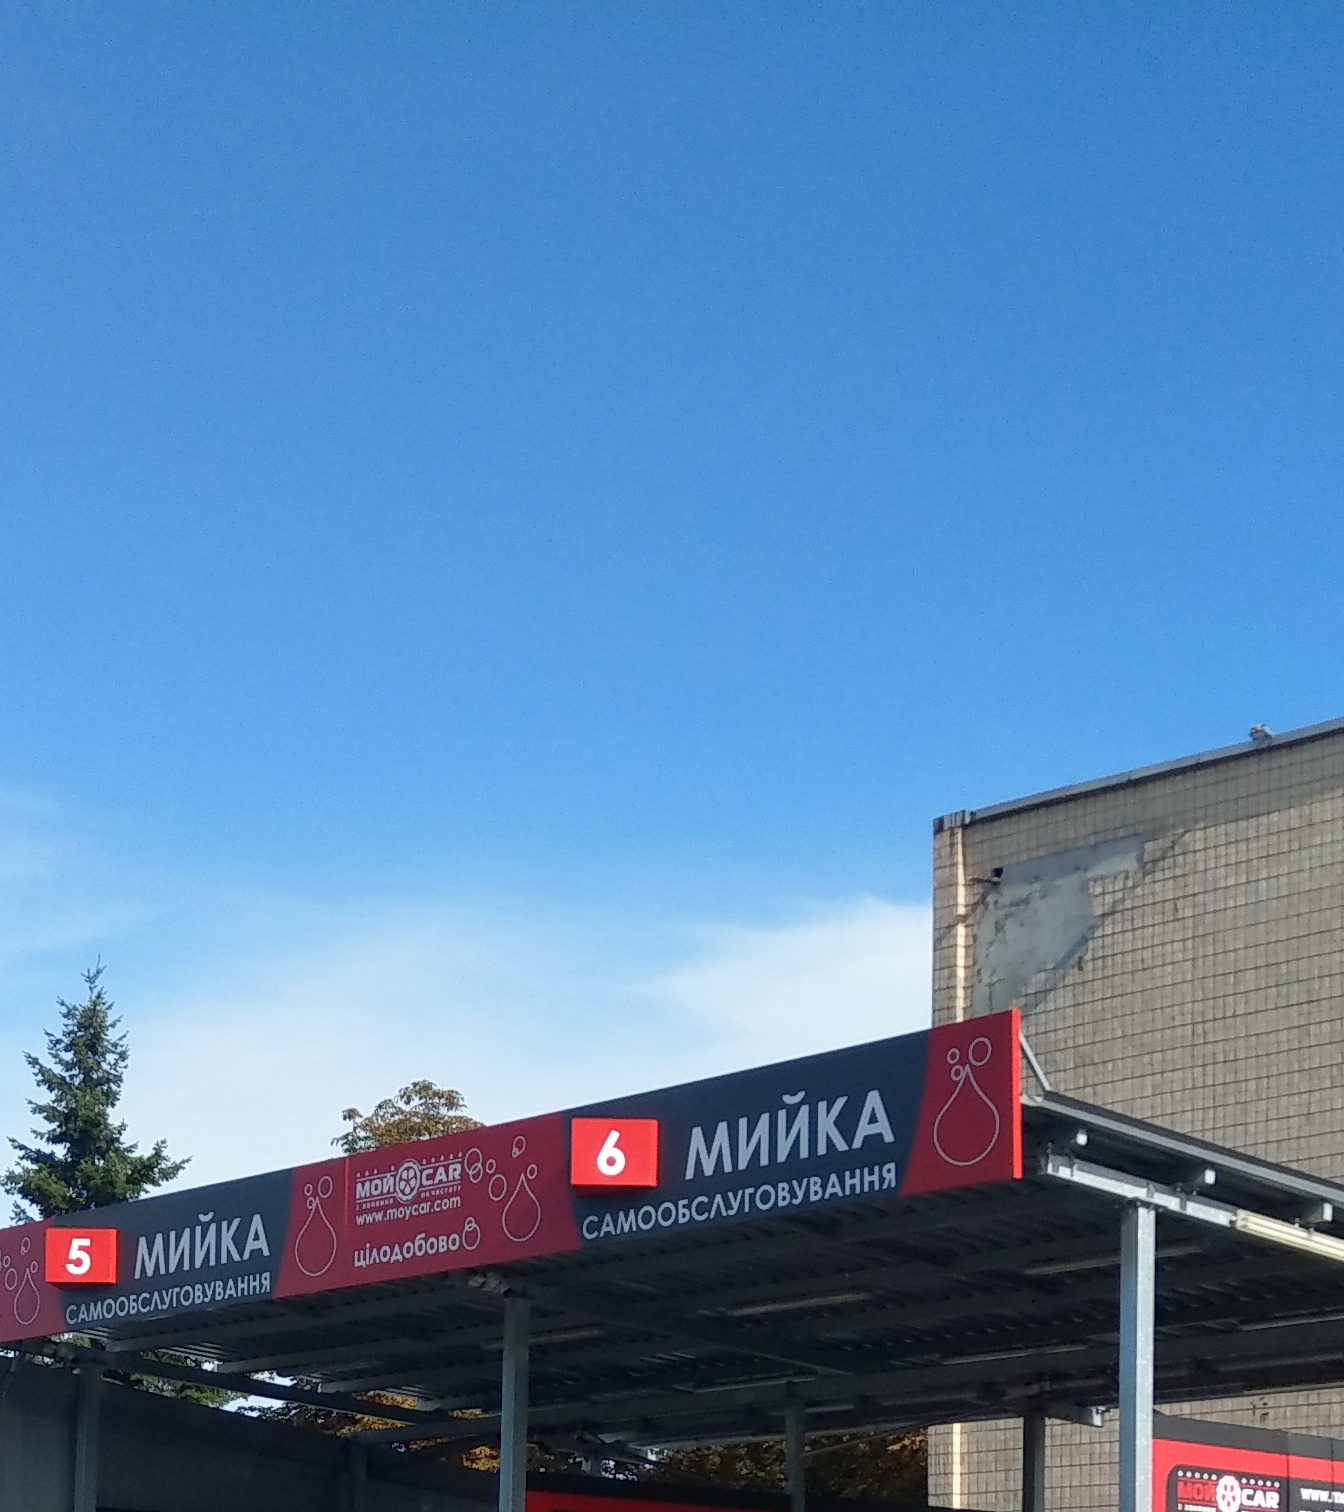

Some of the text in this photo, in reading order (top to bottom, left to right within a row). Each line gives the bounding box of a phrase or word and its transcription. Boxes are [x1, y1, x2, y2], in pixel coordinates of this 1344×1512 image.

[596, 1129, 627, 1176] 6
[684, 1089, 895, 1181] МИЙКА
[356, 1163, 461, 1199] МОЙ CAR
[582, 1162, 897, 1240] САМООБСЛУГОВУВАННЯ
[356, 1196, 461, 1226] www.moycar.com
[65, 1238, 91, 1275] 5
[134, 1211, 270, 1280] МИЙКА
[354, 1232, 460, 1268] цілодобово
[66, 1271, 271, 1325] САМООБСЛУГОВУВАННЯ
[1241, 1489, 1279, 1509] CAR
